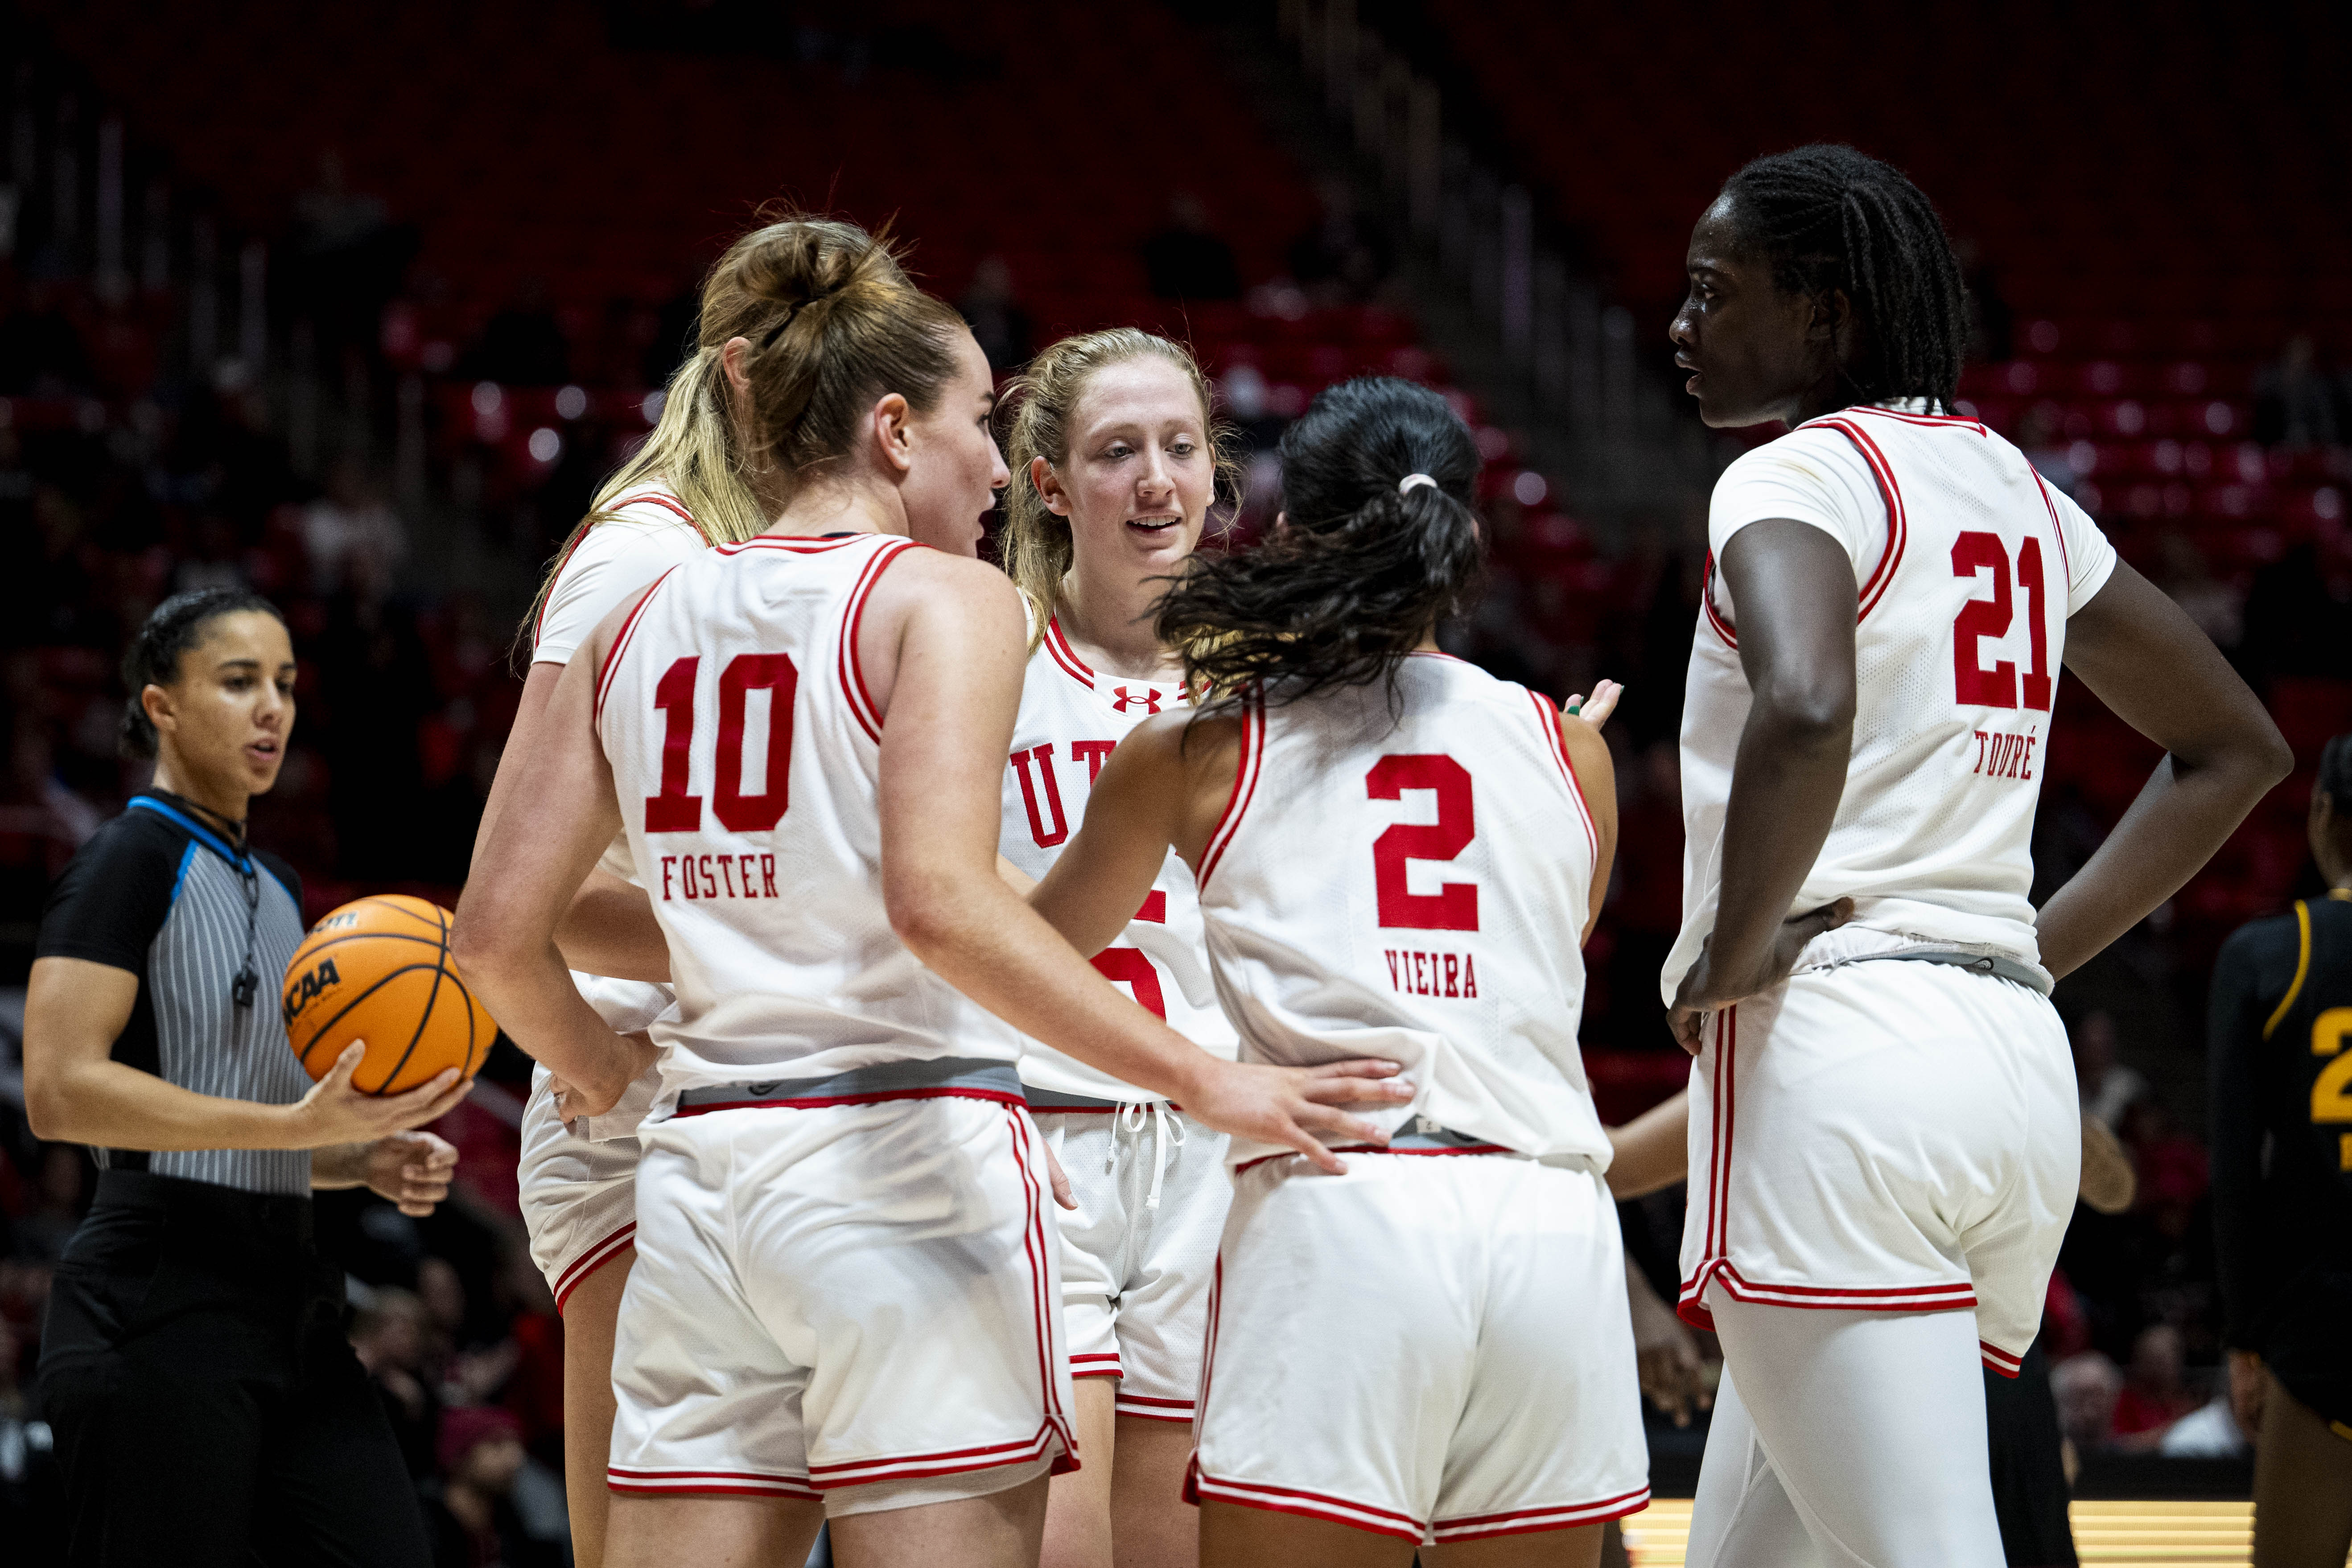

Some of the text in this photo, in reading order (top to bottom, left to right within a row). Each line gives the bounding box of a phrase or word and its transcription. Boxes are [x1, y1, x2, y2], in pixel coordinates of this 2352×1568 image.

[1950, 530, 2051, 713] 21
[645, 652, 799, 833] 10
[1973, 725, 2036, 780] TOURÉ
[661, 853, 779, 901] FOSTER
[1365, 753, 1479, 932] 2
[1384, 949, 1477, 999] VIEIRA
